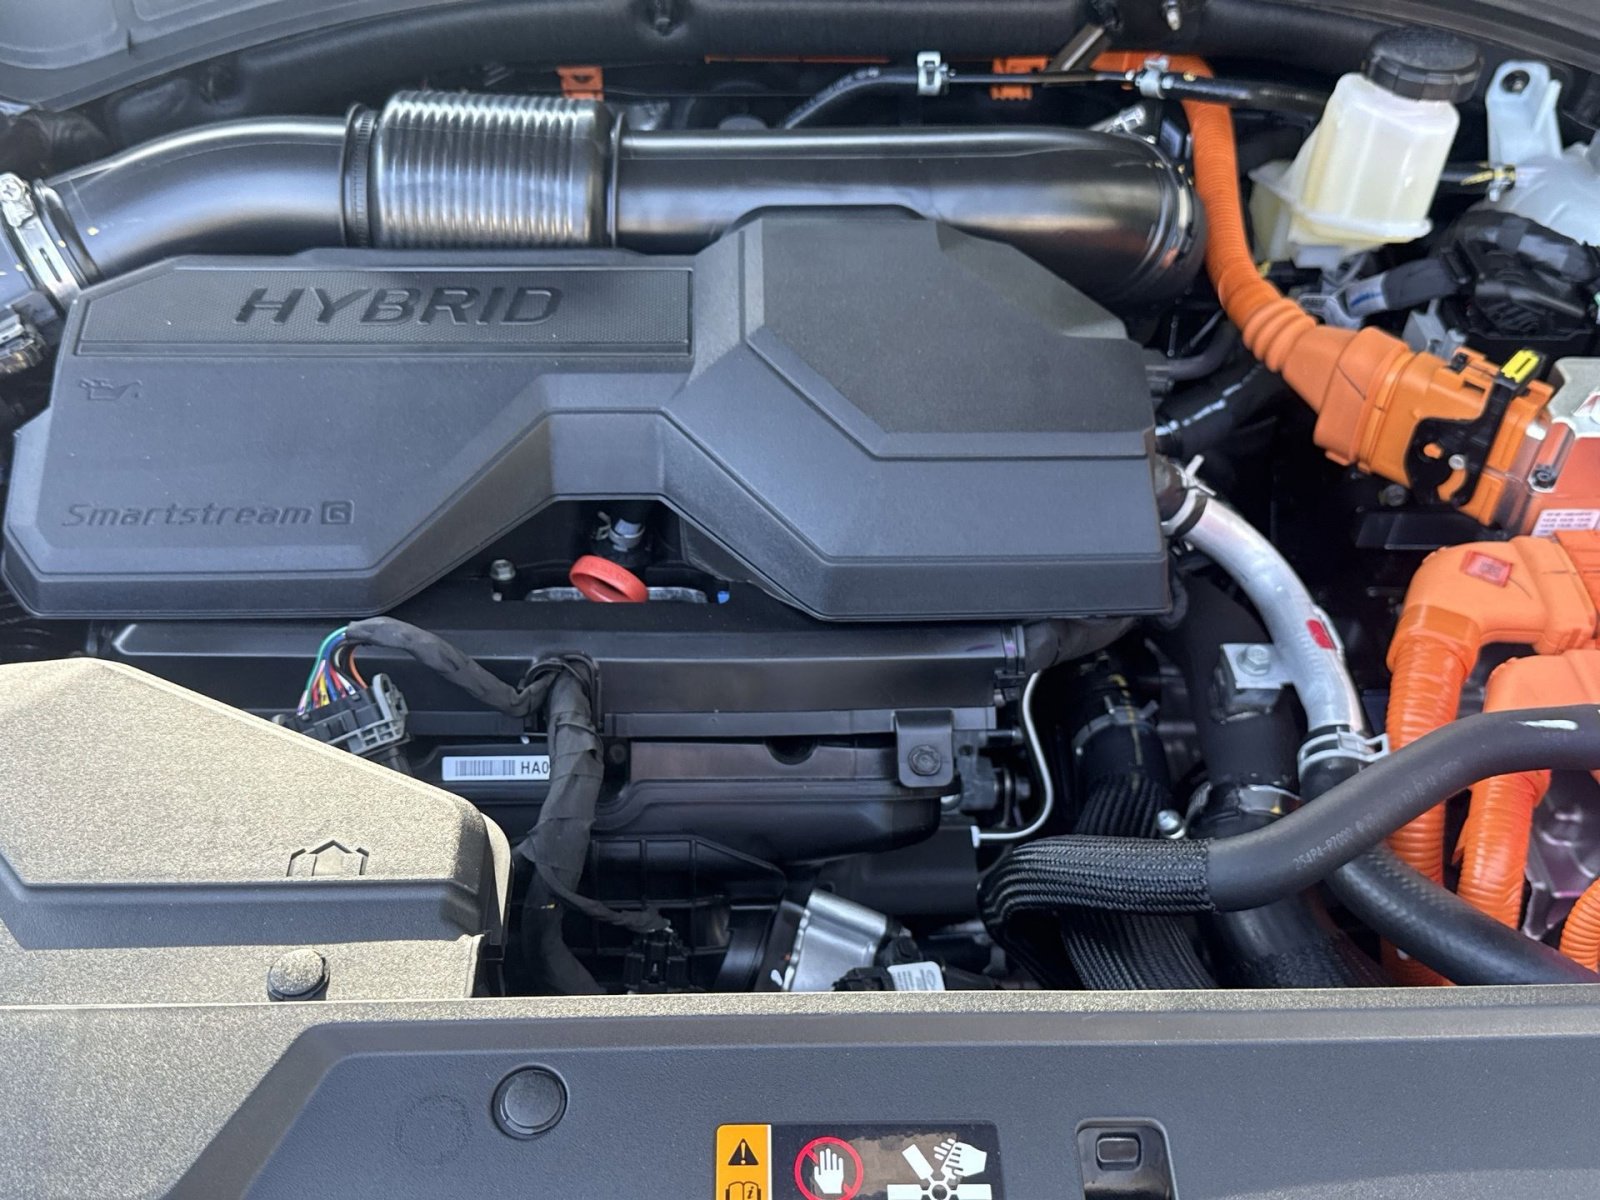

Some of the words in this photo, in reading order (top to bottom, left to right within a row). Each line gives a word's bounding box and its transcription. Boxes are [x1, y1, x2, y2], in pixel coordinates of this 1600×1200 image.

[234, 287, 563, 325] HYBRID
[62, 501, 313, 526] Smartstream
[322, 501, 352, 524] G
